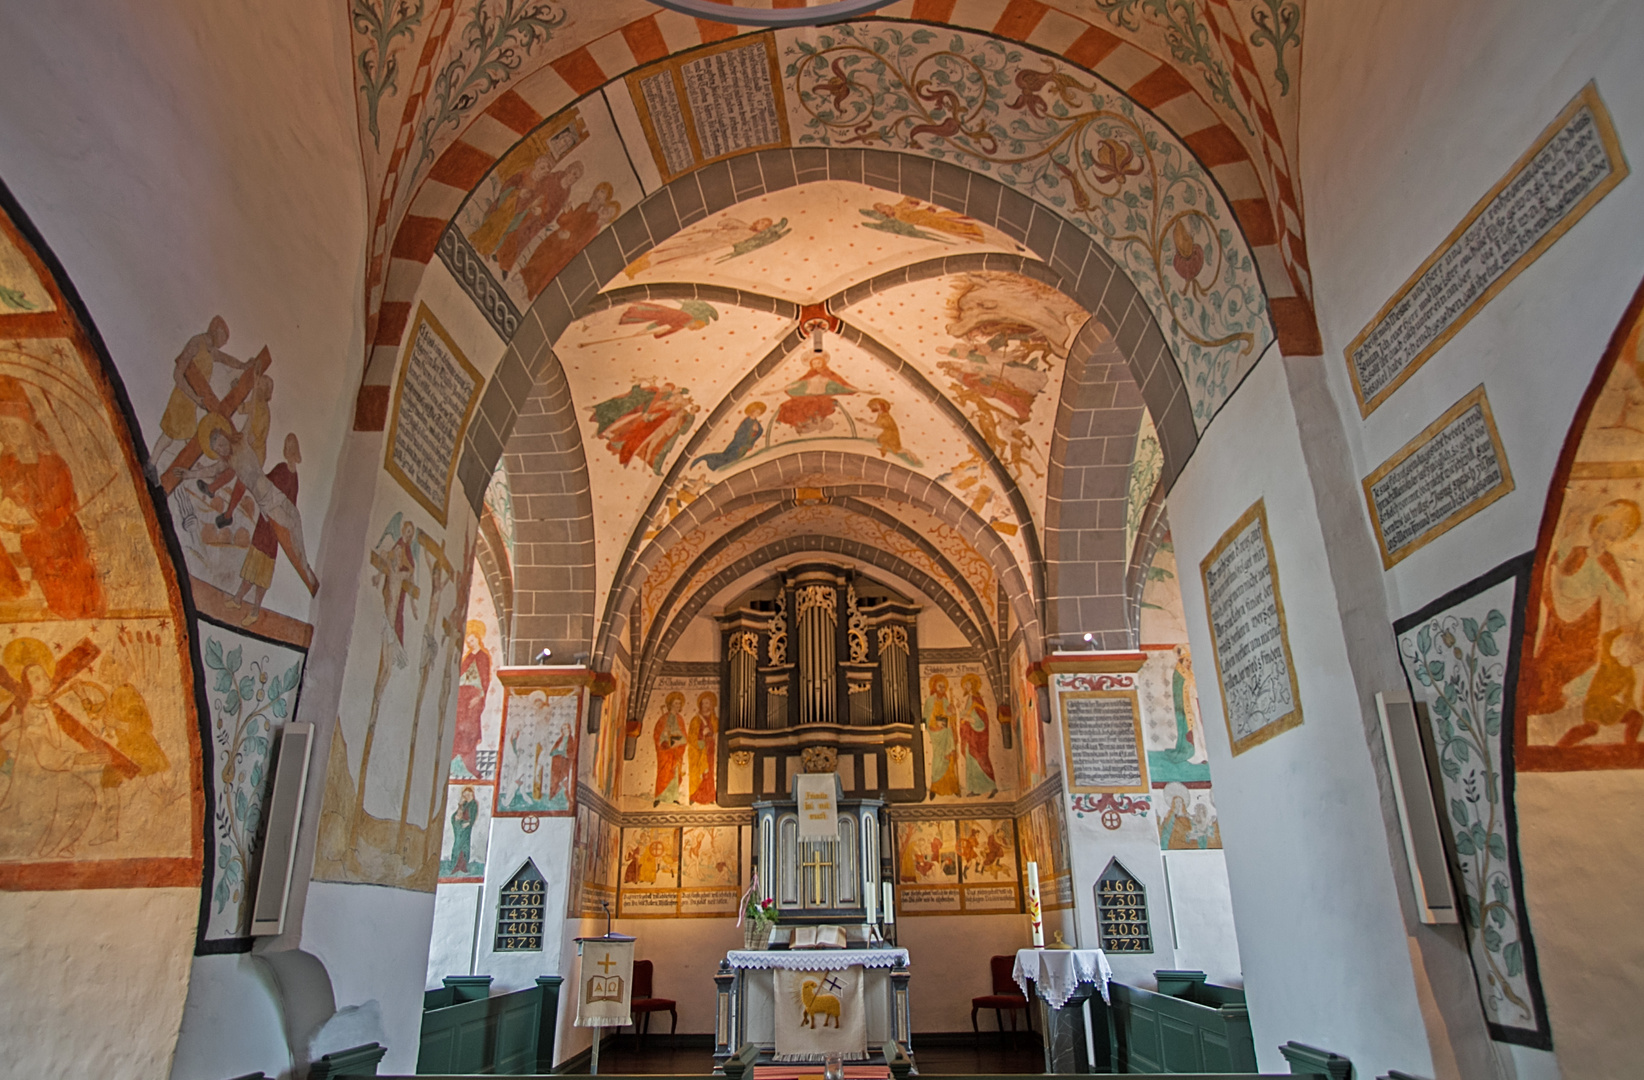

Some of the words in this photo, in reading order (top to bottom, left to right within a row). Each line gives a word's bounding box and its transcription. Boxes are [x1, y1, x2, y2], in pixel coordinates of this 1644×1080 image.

[510, 880, 541, 892] 166
[1104, 880, 1134, 892] 166
[508, 894, 541, 906] 730
[1104, 894, 1137, 906] 730
[508, 908, 538, 920] 432
[1107, 909, 1138, 922] 432
[508, 922, 539, 935] 406
[1108, 924, 1140, 936] 406
[507, 937, 536, 949] 272
[1110, 938, 1142, 951] 272
